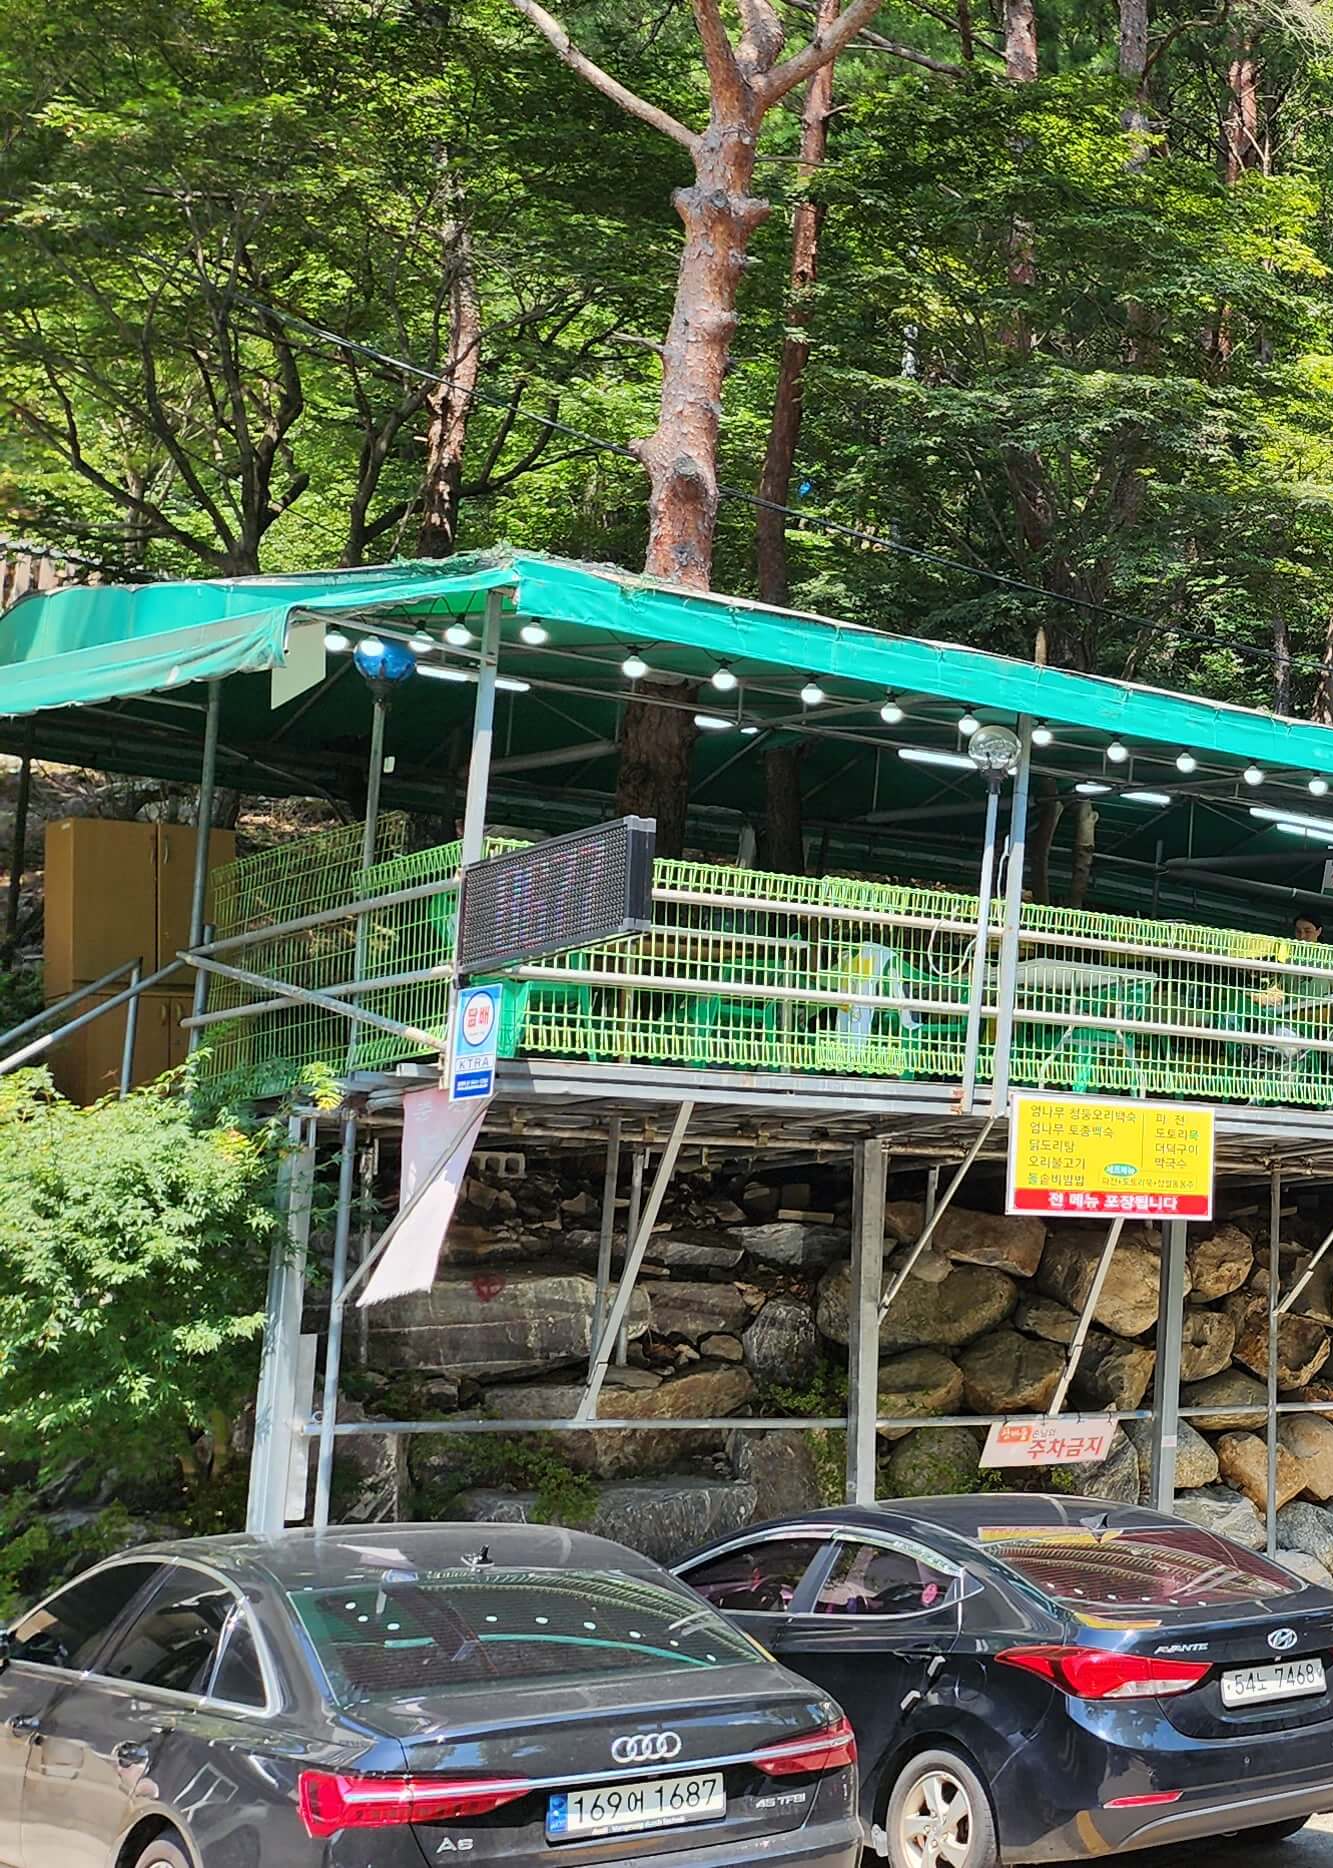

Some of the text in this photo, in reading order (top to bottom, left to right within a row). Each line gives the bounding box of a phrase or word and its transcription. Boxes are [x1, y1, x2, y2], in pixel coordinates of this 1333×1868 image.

[1048, 1191, 1178, 1211] 전 메뉴 포장됩니다
[1027, 1436, 1104, 1460] 주차금지
[1153, 1643, 1209, 1655] AVANTE
[1234, 1663, 1315, 1695] 54노 7468
[574, 1778, 717, 1823] 169어 1687
[755, 1792, 806, 1809] 45 TFSI
[436, 1837, 474, 1854] A6
